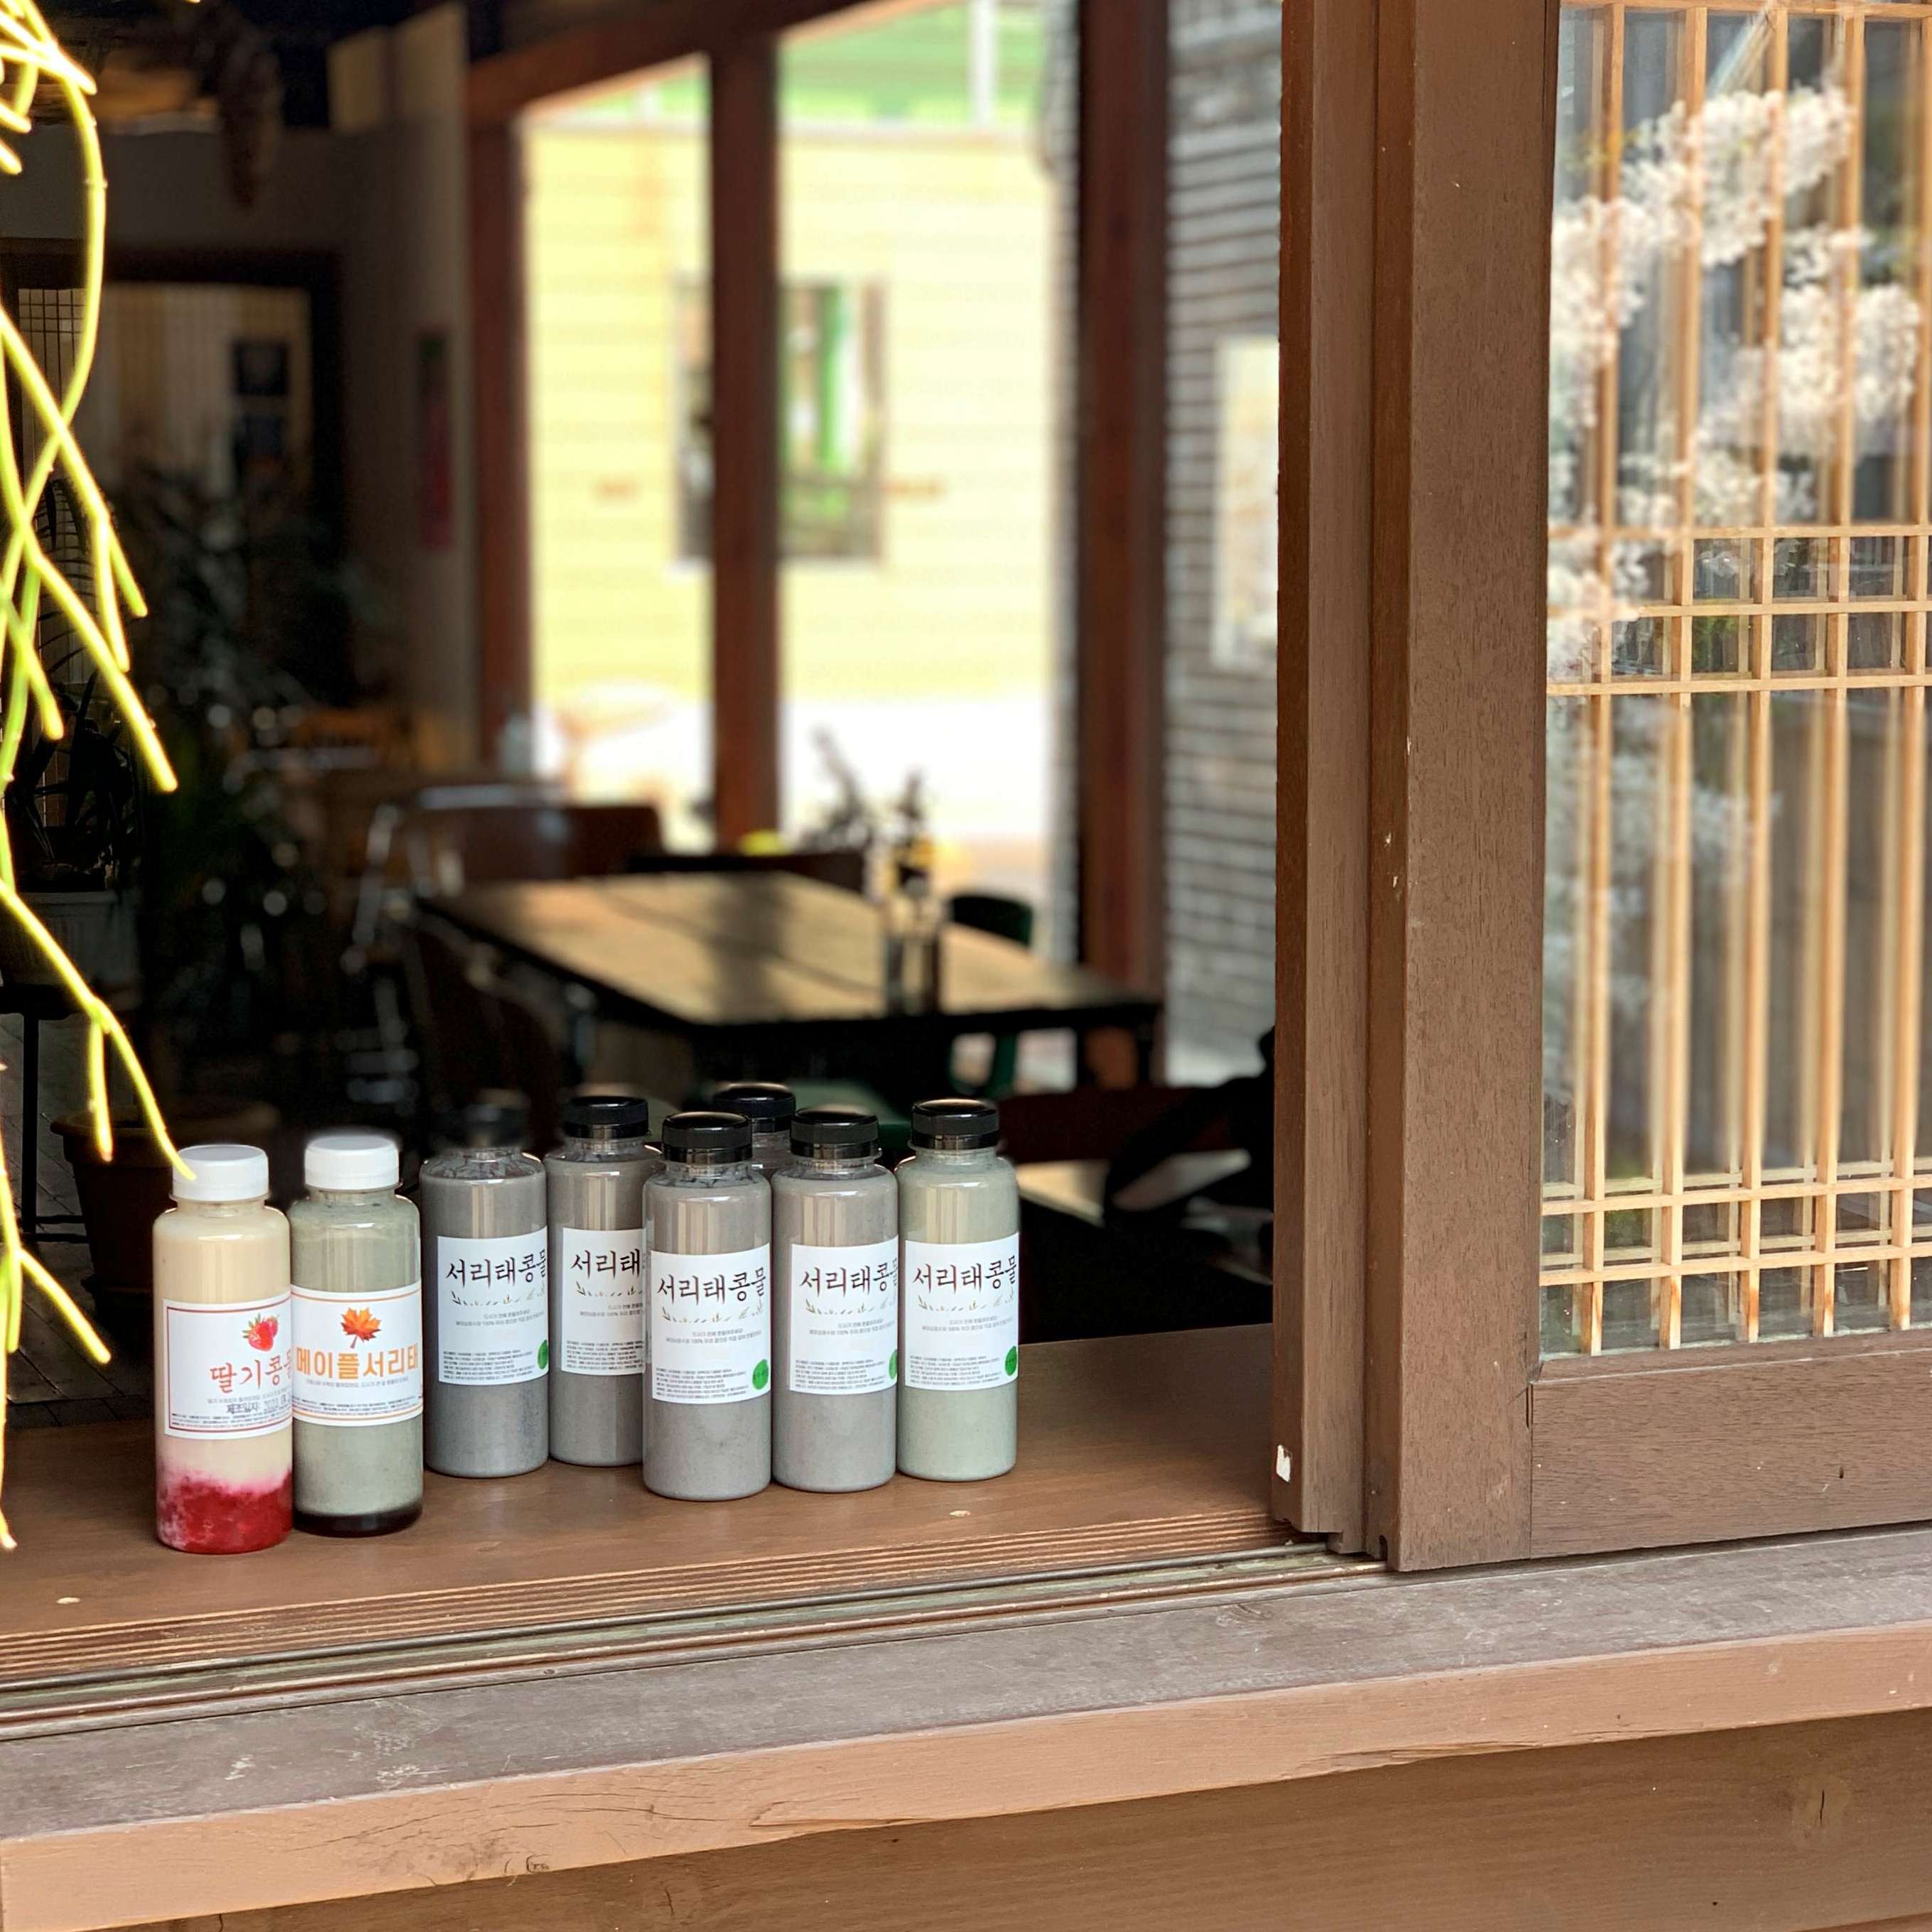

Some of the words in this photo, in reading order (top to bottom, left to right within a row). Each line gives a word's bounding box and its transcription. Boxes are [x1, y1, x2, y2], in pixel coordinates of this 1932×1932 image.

[446, 1249, 546, 1288] 서리태콩물
[571, 1248, 642, 1279] 서리태
[913, 1255, 1016, 1295] 서리태콩물
[657, 1266, 766, 1306] 서리태콩물
[295, 1342, 418, 1380] 메이플서리태
